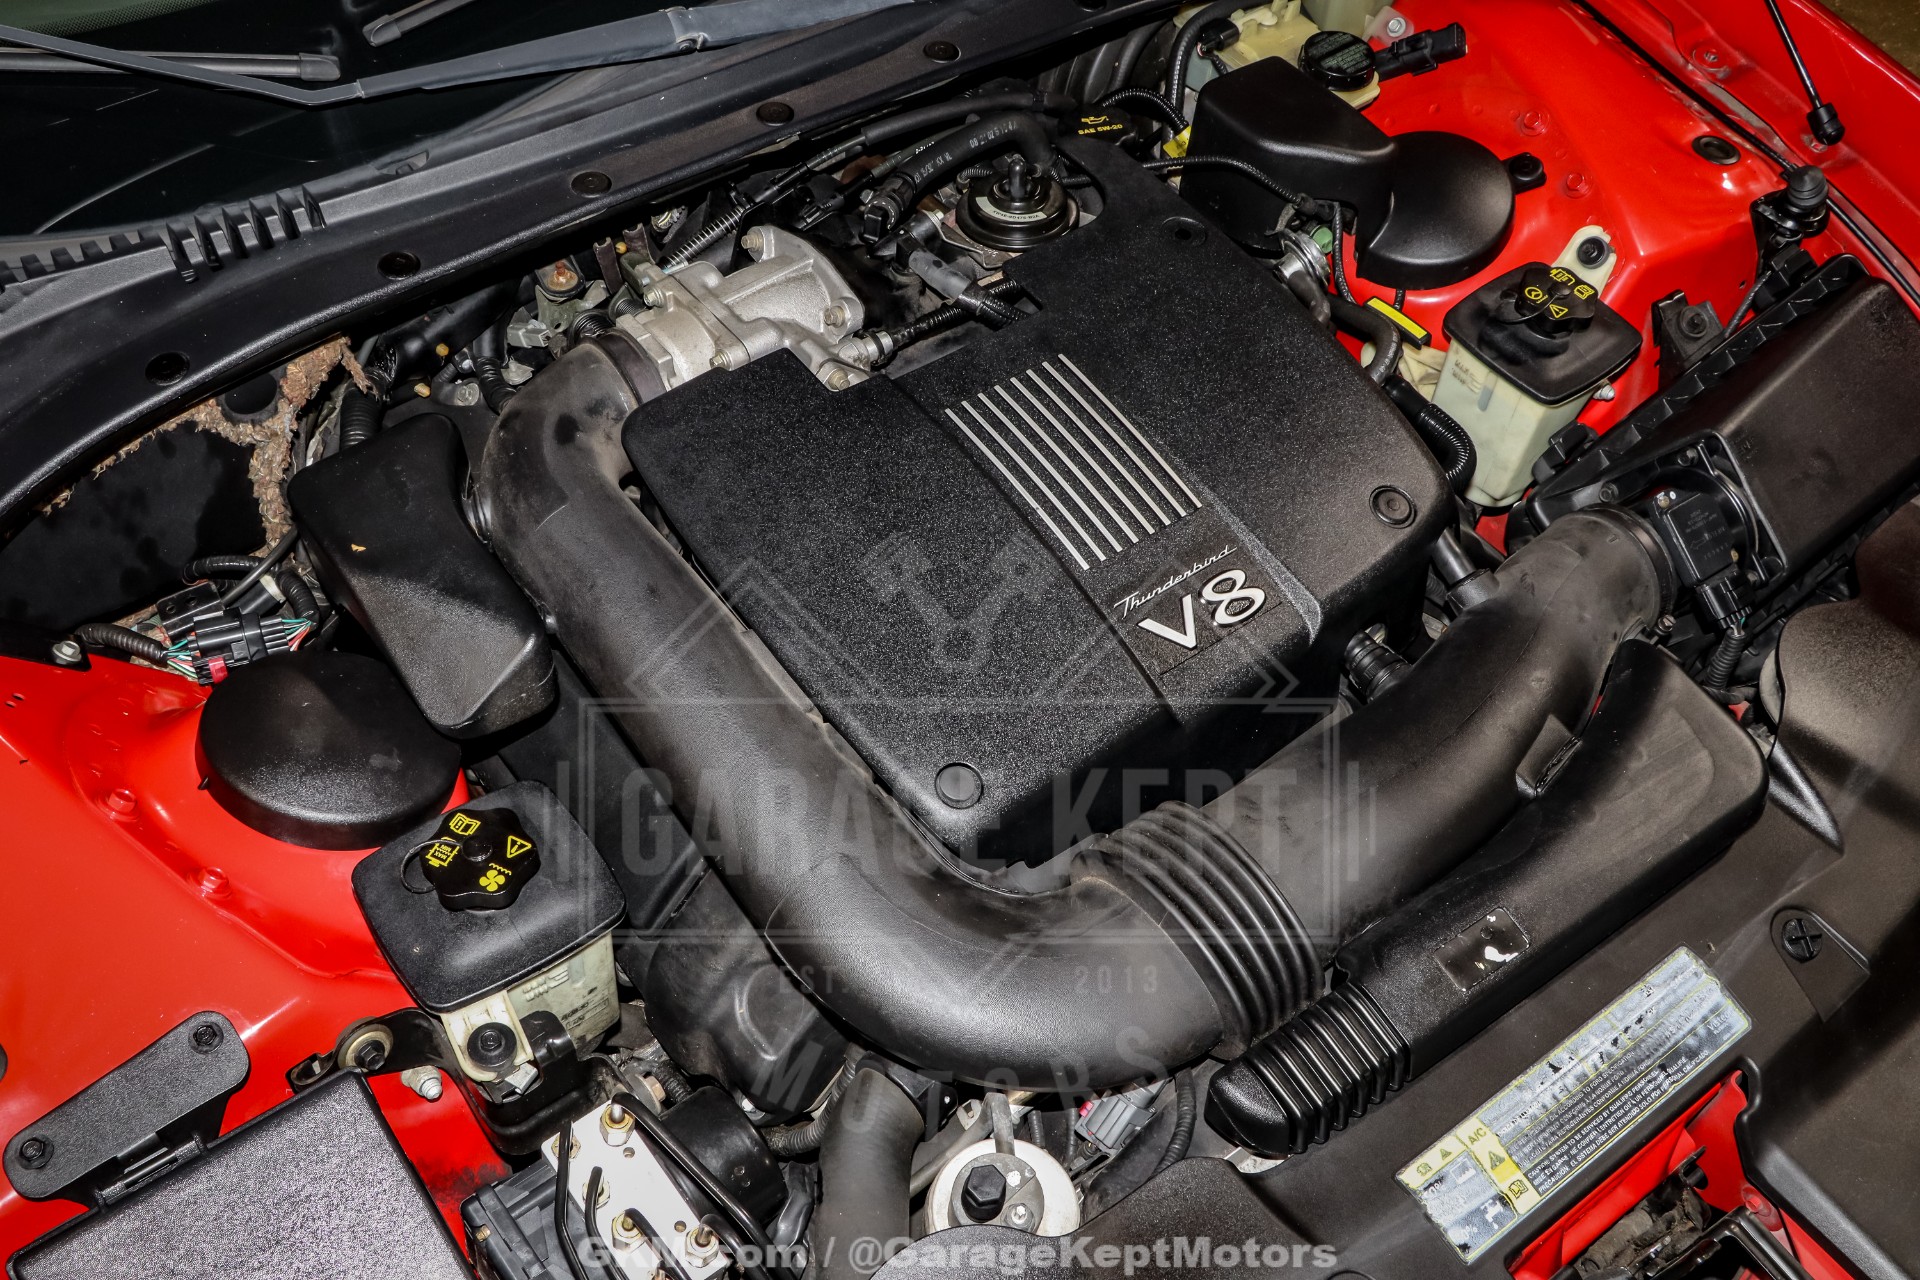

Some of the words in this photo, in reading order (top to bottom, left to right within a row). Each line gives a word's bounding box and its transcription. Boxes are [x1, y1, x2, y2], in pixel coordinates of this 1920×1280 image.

[1097, 124, 1123, 132] 5W-20
[1113, 545, 1238, 620] Thunderbird
[1137, 569, 1265, 649] V8
[1467, 1127, 1487, 1145] A/C
[1566, 1137, 1576, 1146] TO
[1573, 1132, 1582, 1141] BE
[1579, 1113, 1604, 1135] SERVICED
[1601, 1108, 1611, 1117] BY
